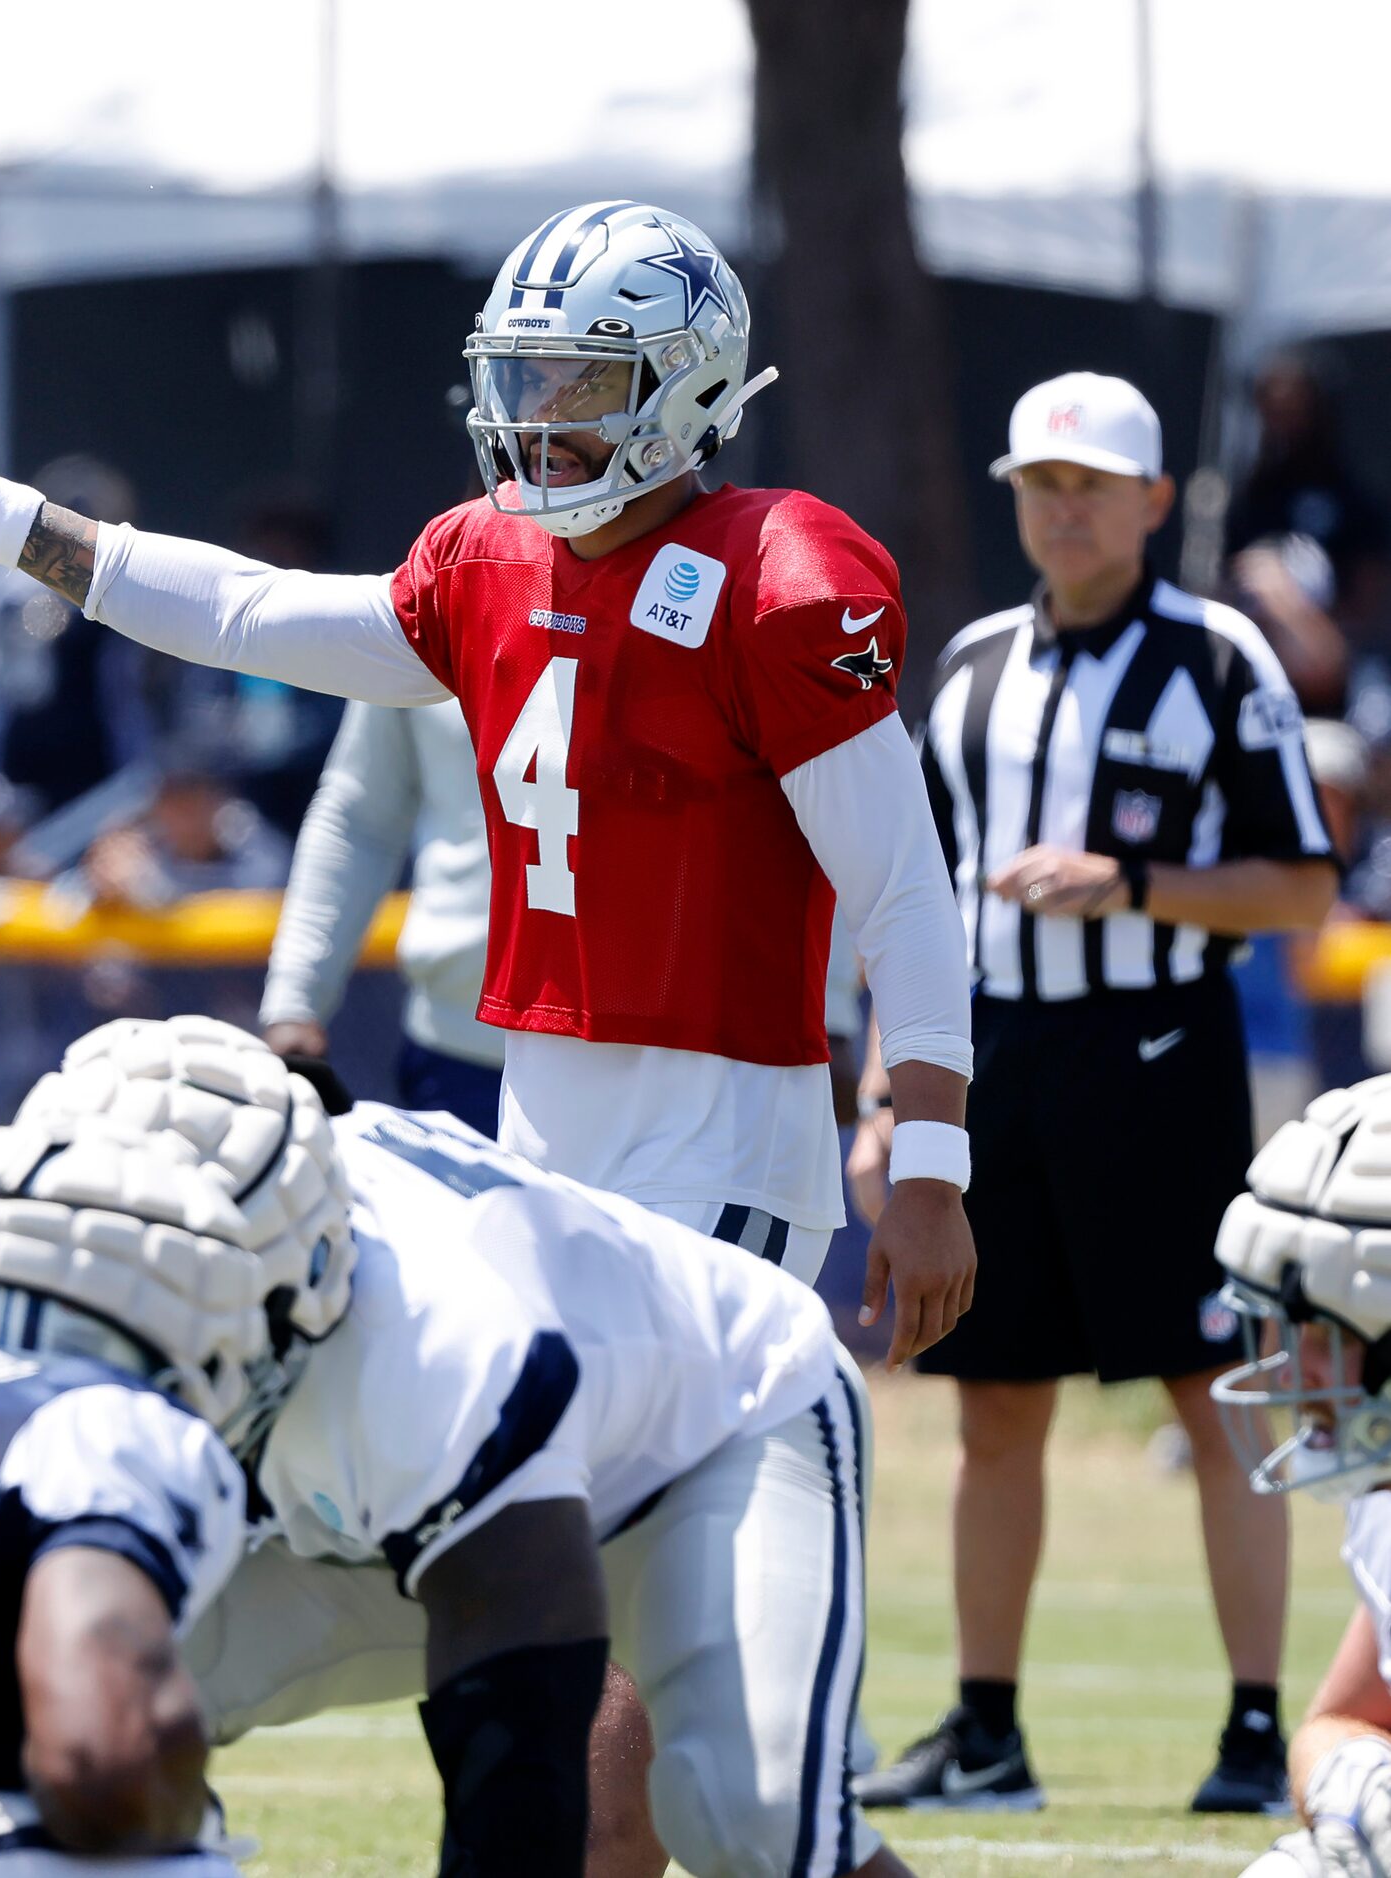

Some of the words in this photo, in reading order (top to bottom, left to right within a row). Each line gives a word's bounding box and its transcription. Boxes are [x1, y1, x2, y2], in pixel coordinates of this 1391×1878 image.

[507, 318, 551, 329] COWBOYS
[528, 609, 586, 635] COWBOYS
[646, 602, 692, 632] AT&T
[492, 656, 580, 918] 4
